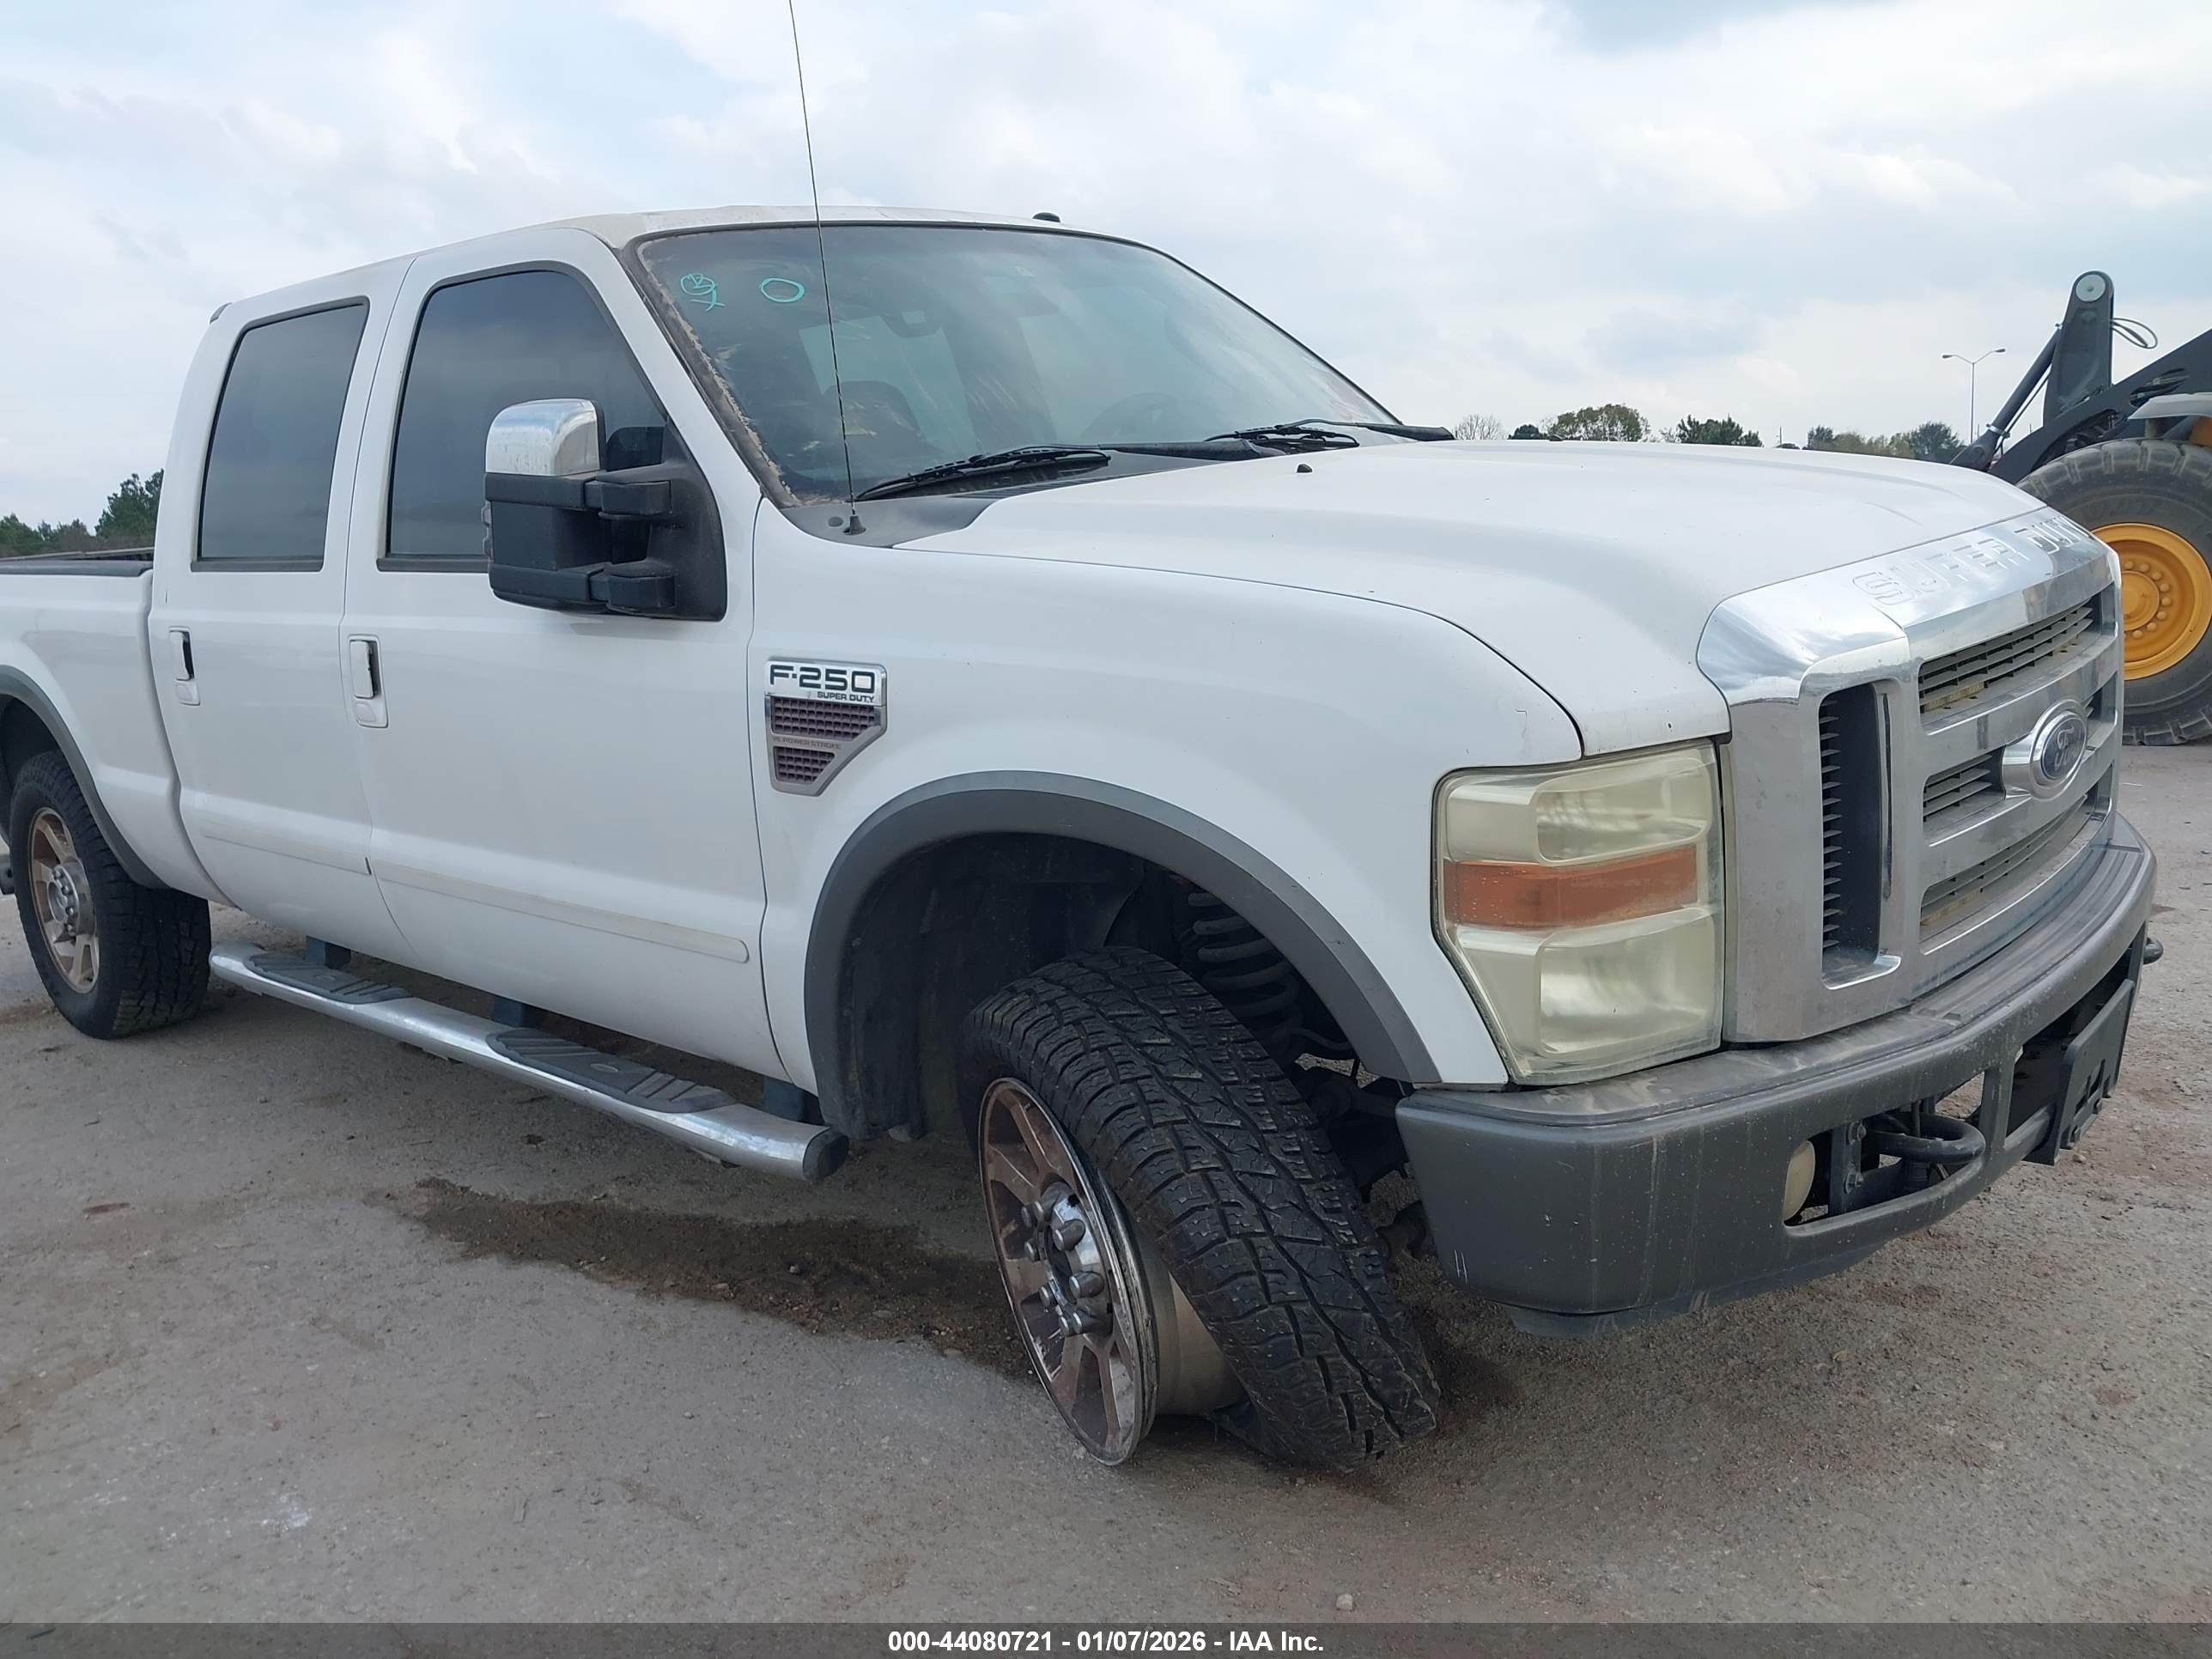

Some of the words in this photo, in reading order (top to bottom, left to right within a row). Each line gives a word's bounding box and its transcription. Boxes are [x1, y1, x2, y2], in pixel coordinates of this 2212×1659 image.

[1851, 536, 2031, 606] SUPER
[769, 664, 876, 694] F-250
[817, 690, 848, 702] SUPER
[849, 693, 876, 703] DUTY
